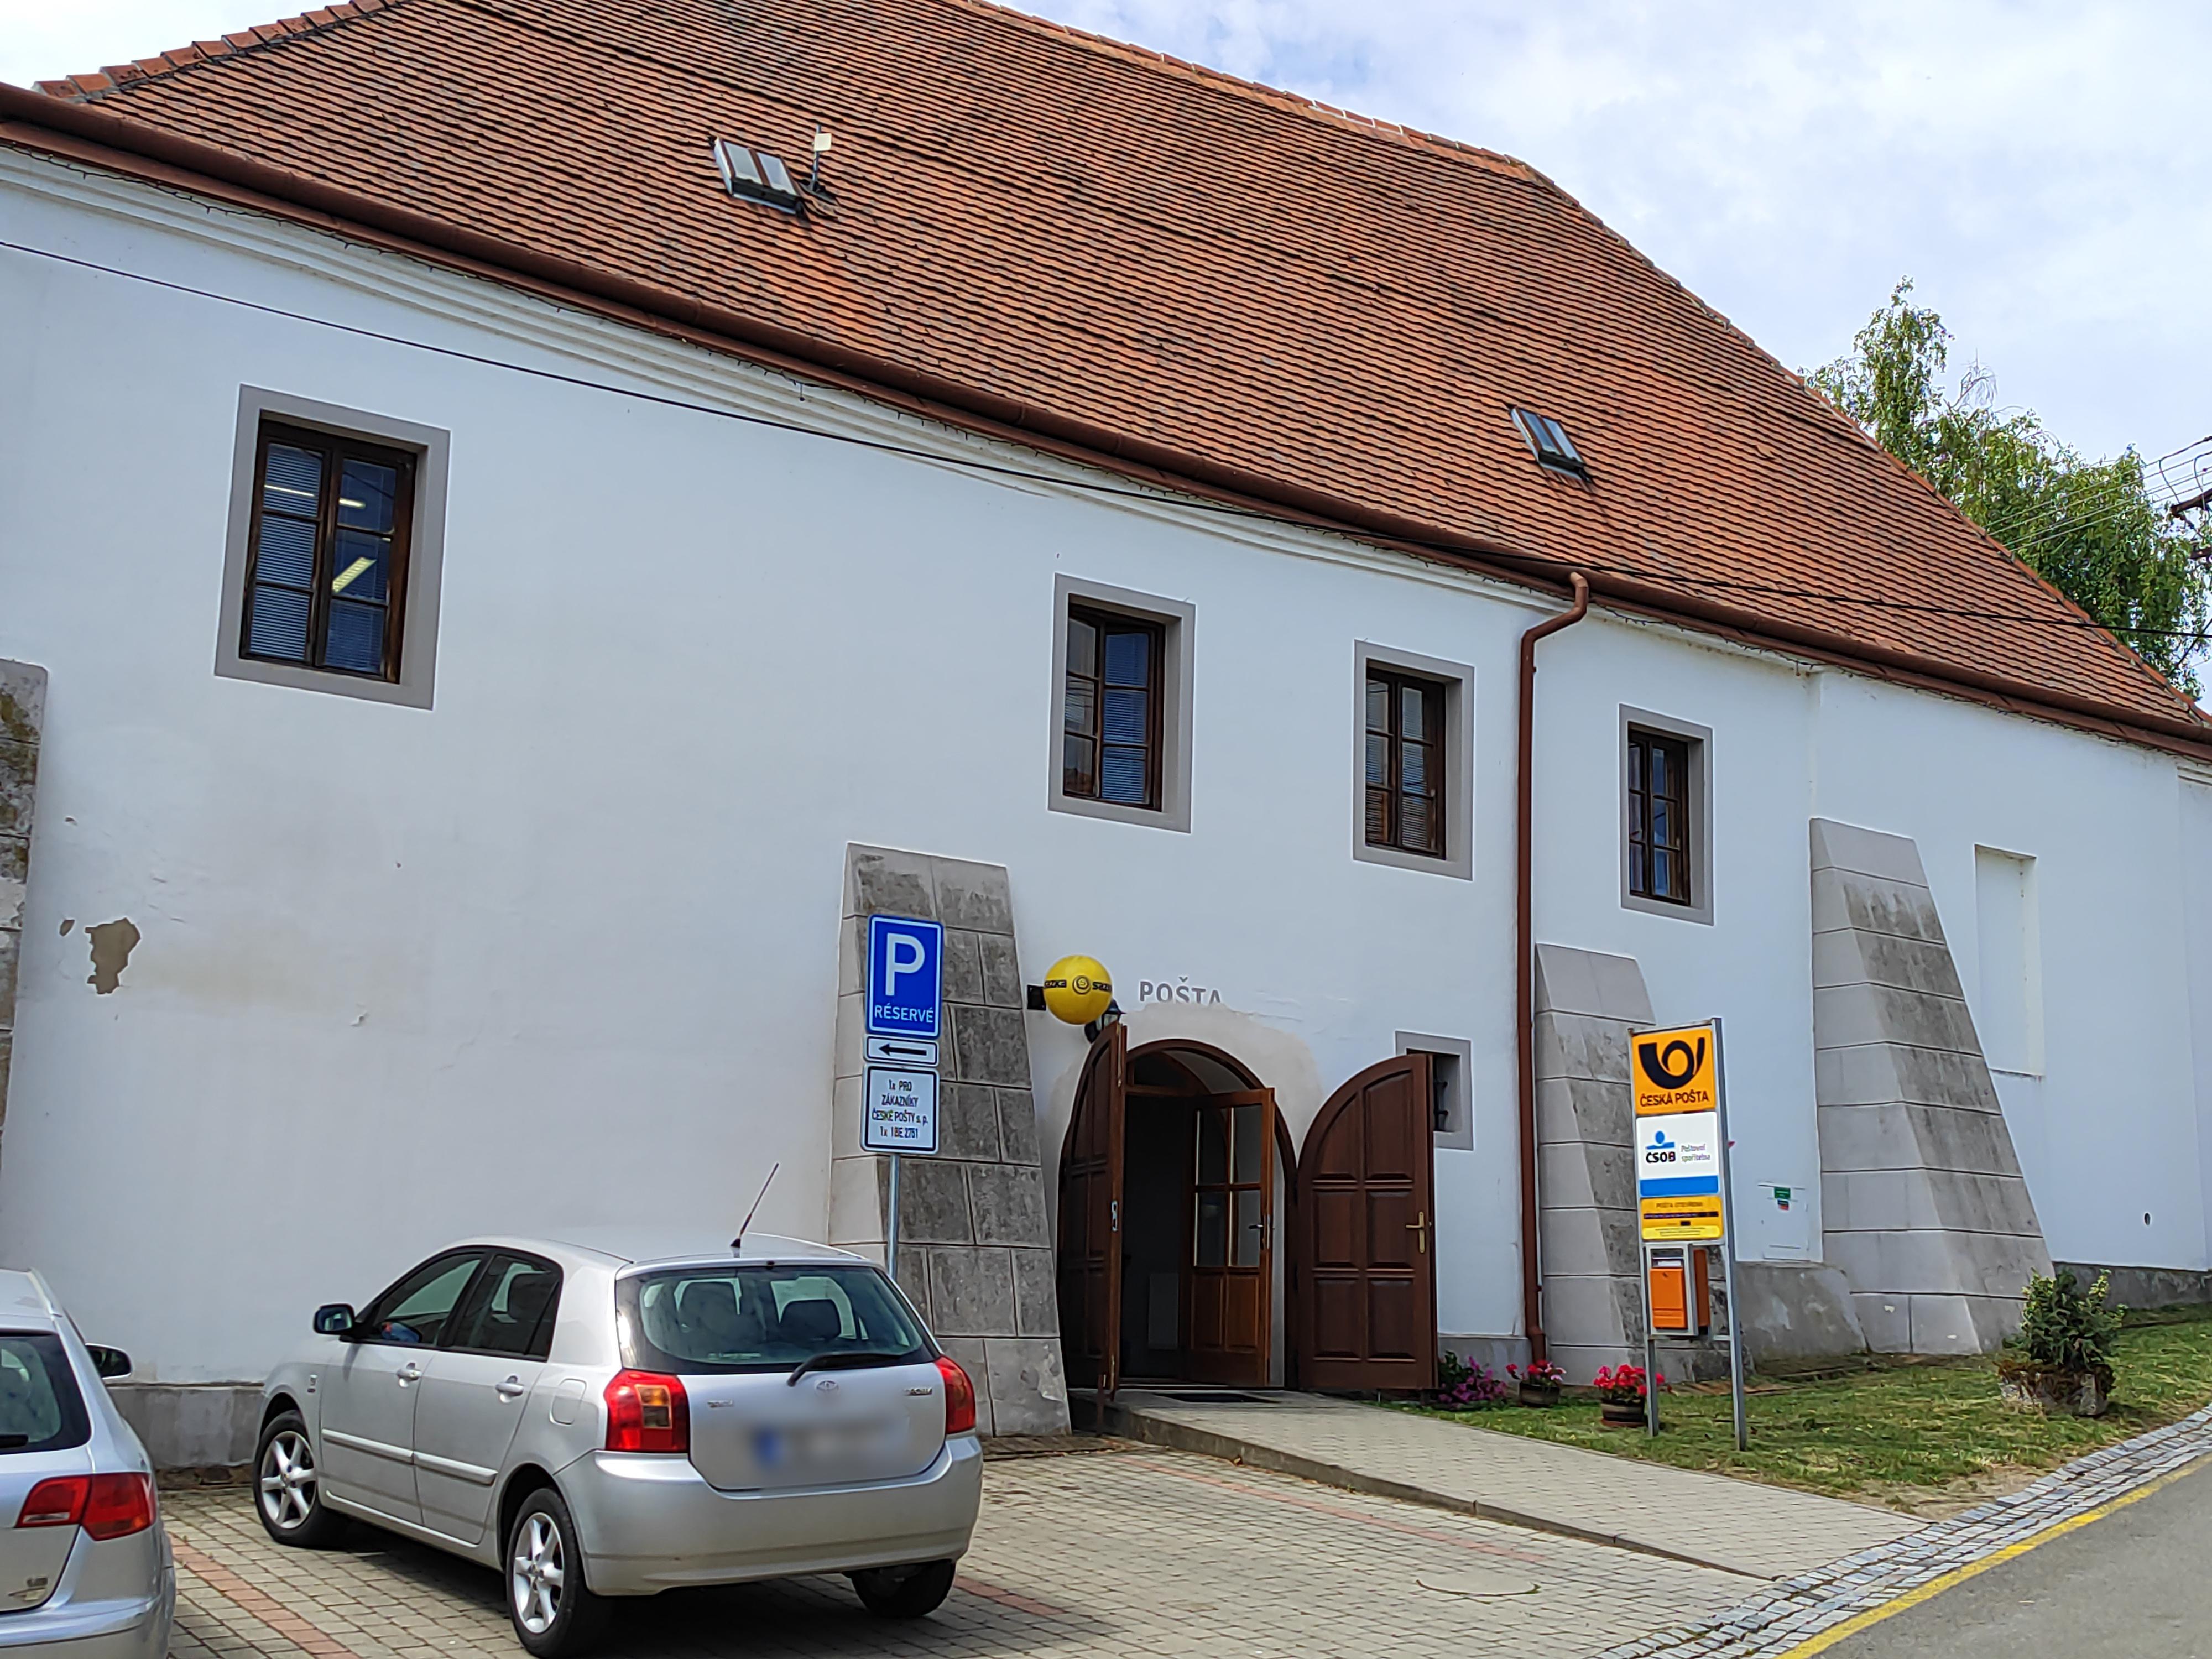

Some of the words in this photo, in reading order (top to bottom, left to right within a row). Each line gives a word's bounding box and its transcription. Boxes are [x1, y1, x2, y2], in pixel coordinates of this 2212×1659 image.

[885, 932, 925, 996] P
[1140, 977, 1220, 1004] POŠTA
[874, 1003, 934, 1023] RÉSERVÉ
[899, 1080, 912, 1092] PRO
[881, 1093, 919, 1107] ZÁKAZNÍKY
[1640, 1092, 1673, 1107] ČESKÁ
[1675, 1089, 1709, 1104] POŠTA
[872, 1107, 894, 1121] ČESKÉ
[894, 1109, 916, 1123] POŠTY
